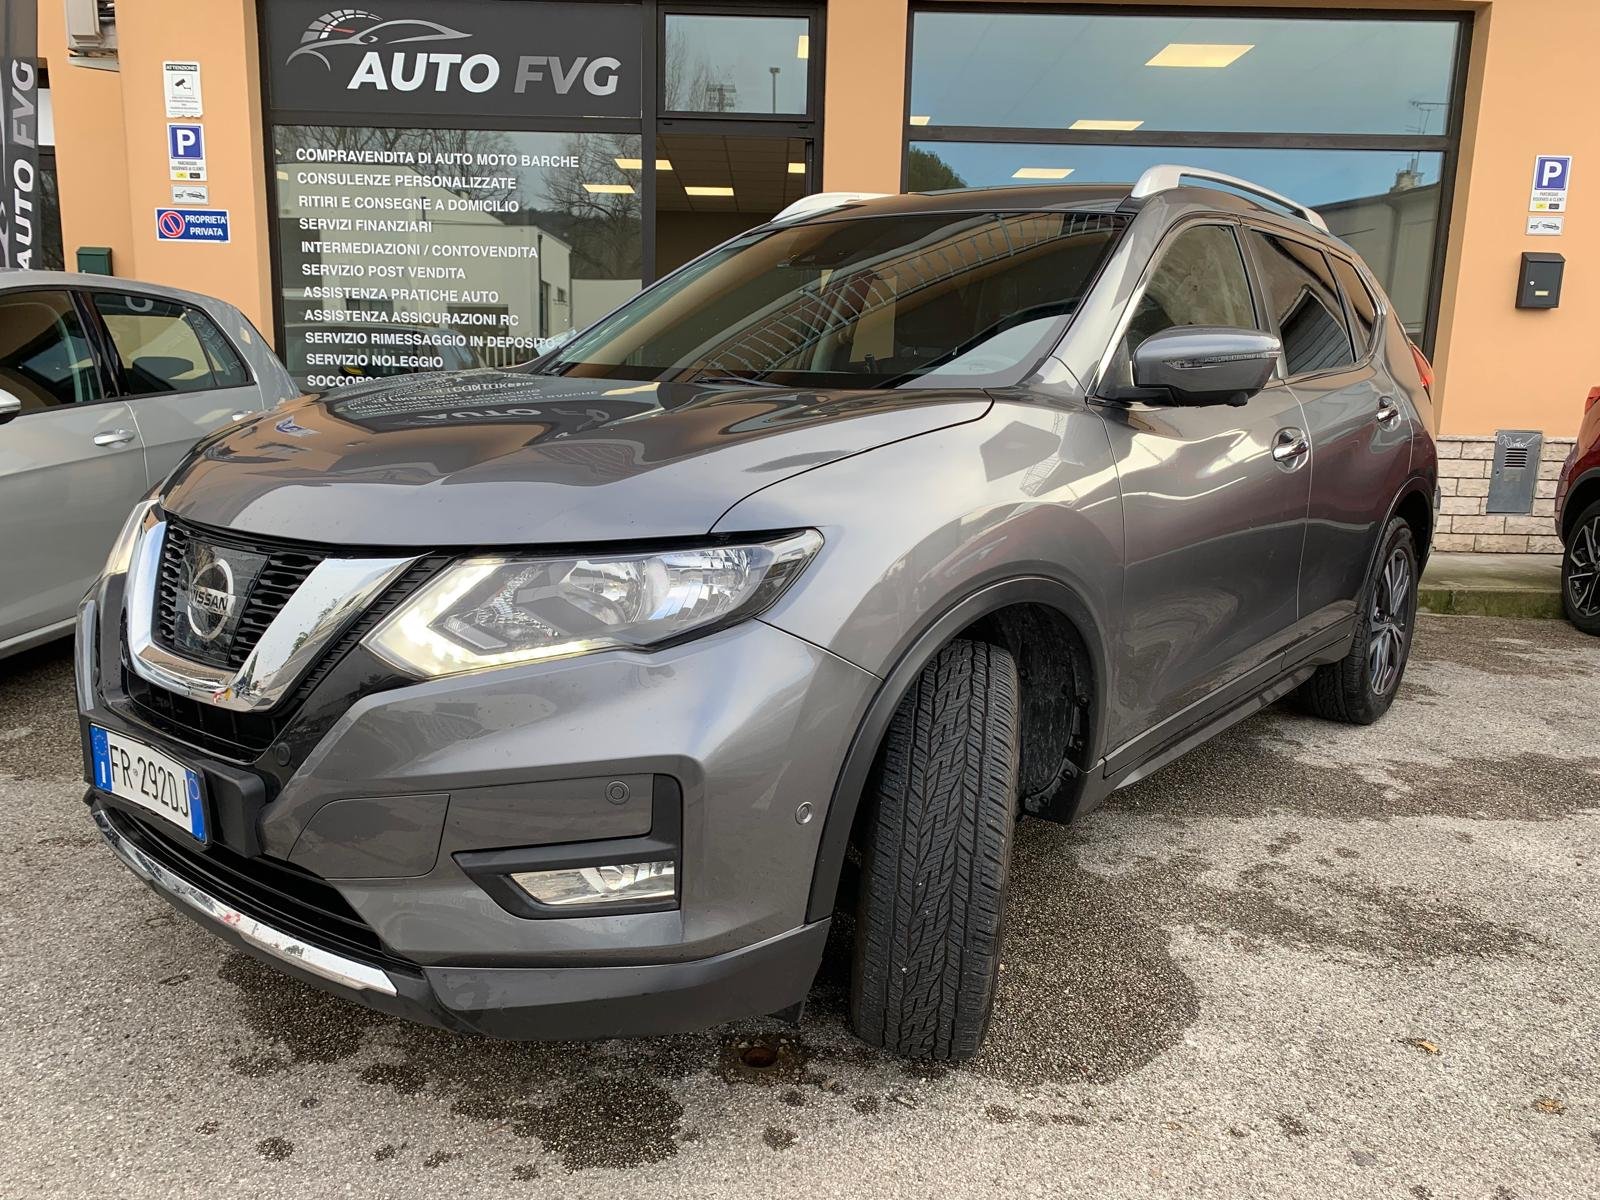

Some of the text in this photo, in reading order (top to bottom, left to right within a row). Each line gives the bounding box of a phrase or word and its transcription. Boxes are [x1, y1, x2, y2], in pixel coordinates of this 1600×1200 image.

[346, 51, 622, 96] AUTO FVG
[176, 129, 196, 155] P
[11, 59, 35, 271] AUTO FVG
[296, 148, 579, 168] COMPRAVENDITA DI AUTO MOTO BARCHE
[297, 172, 516, 190] CONSULENZE PERSONALIZZATE
[1541, 161, 1562, 186] P
[298, 195, 519, 213] RITIRI E CONSEGNE A DOMICILIO
[190, 227, 223, 236] PRIVATA
[299, 218, 432, 233] SERVIZI FINANZIARI
[301, 241, 538, 259] INTERMEDIAZIONI / CONTOVENDITA
[302, 263, 466, 280] SERVIZIO POST VENDITA
[303, 287, 499, 303] ASSISTENZA PRATICHE AUTO
[304, 309, 519, 326] ASSISTENZA ASSICURAZIONI RC
[305, 332, 555, 349] SERVIZIO RIMESSAGGIO IN DEPOSITO
[306, 353, 443, 368] SERVIZIO NOLEGGIO
[190, 589, 228, 611] NISSAN
